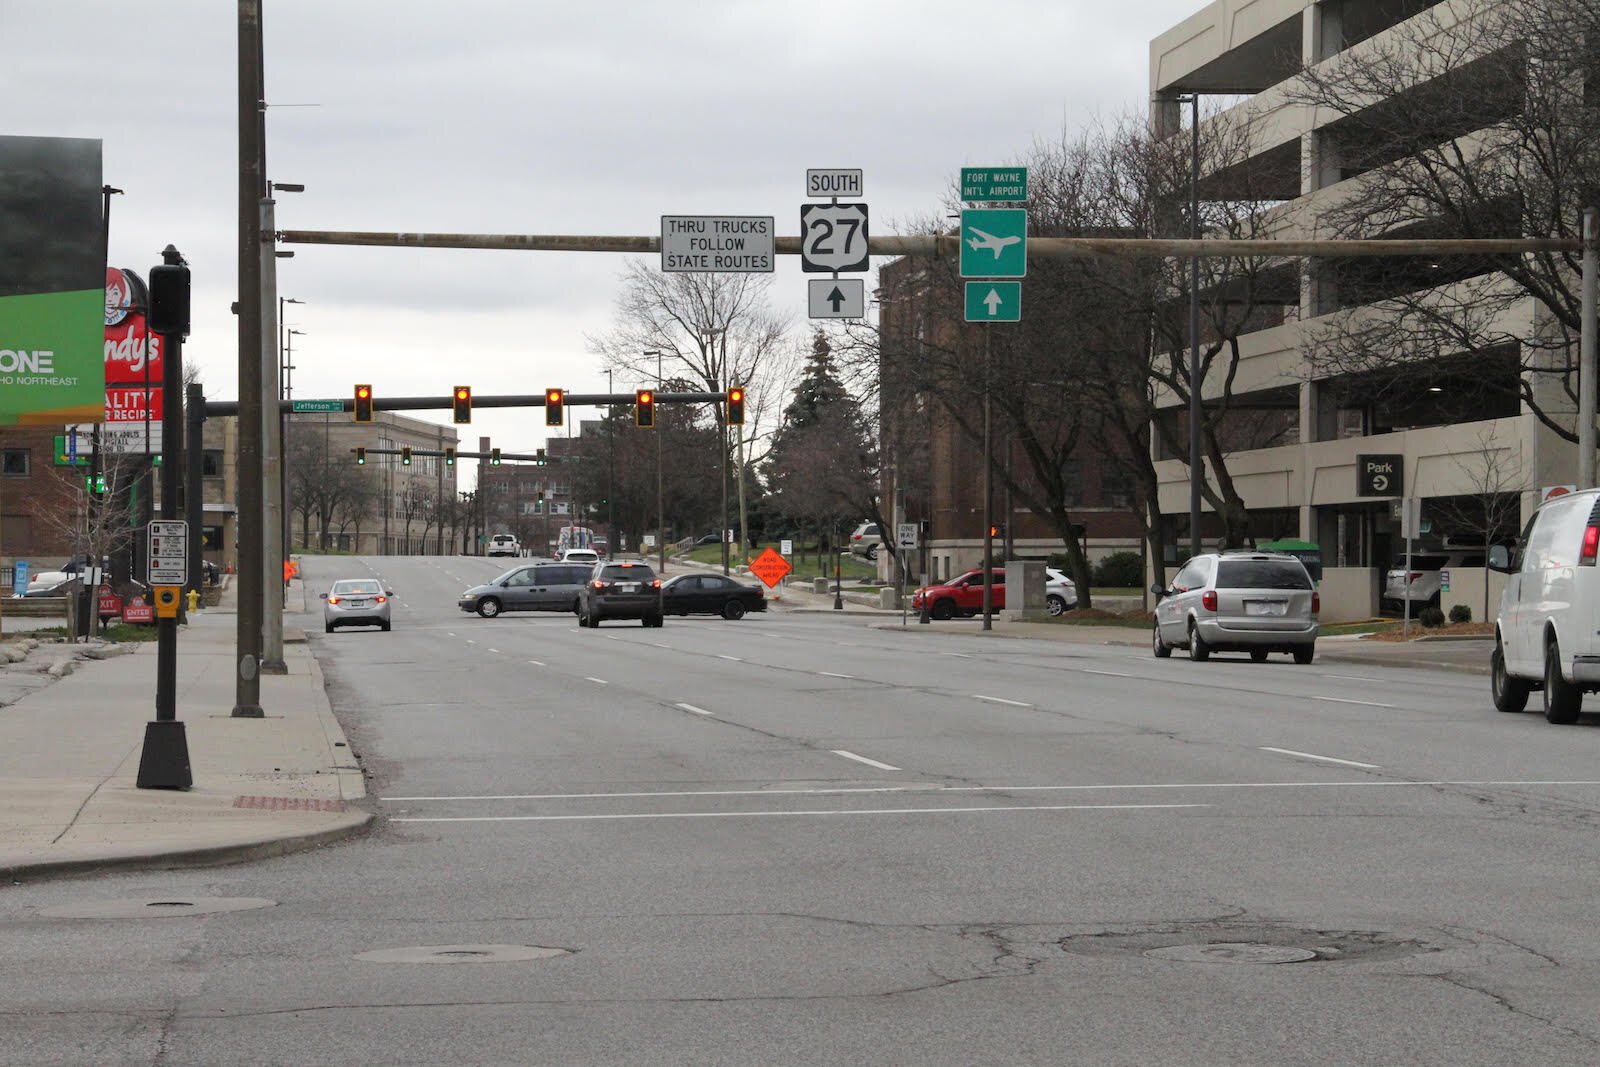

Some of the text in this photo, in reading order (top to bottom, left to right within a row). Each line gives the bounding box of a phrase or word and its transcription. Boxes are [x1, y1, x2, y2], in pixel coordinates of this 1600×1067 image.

[811, 175, 858, 191] SOUTH
[967, 173, 1020, 183] FORT WAYNE
[963, 186, 1023, 196] INT'L AIRPORT
[669, 220, 767, 233] THRU TRUCKS
[810, 218, 860, 255] 27
[690, 238, 745, 251] FOLLOW
[668, 255, 768, 268] STATE ROUTES
[104, 325, 159, 371] ndy's
[17, 376, 78, 386] NORTHEAST
[104, 392, 154, 408] ALITY
[1367, 462, 1393, 473] Park
[99, 600, 114, 608] XIT
